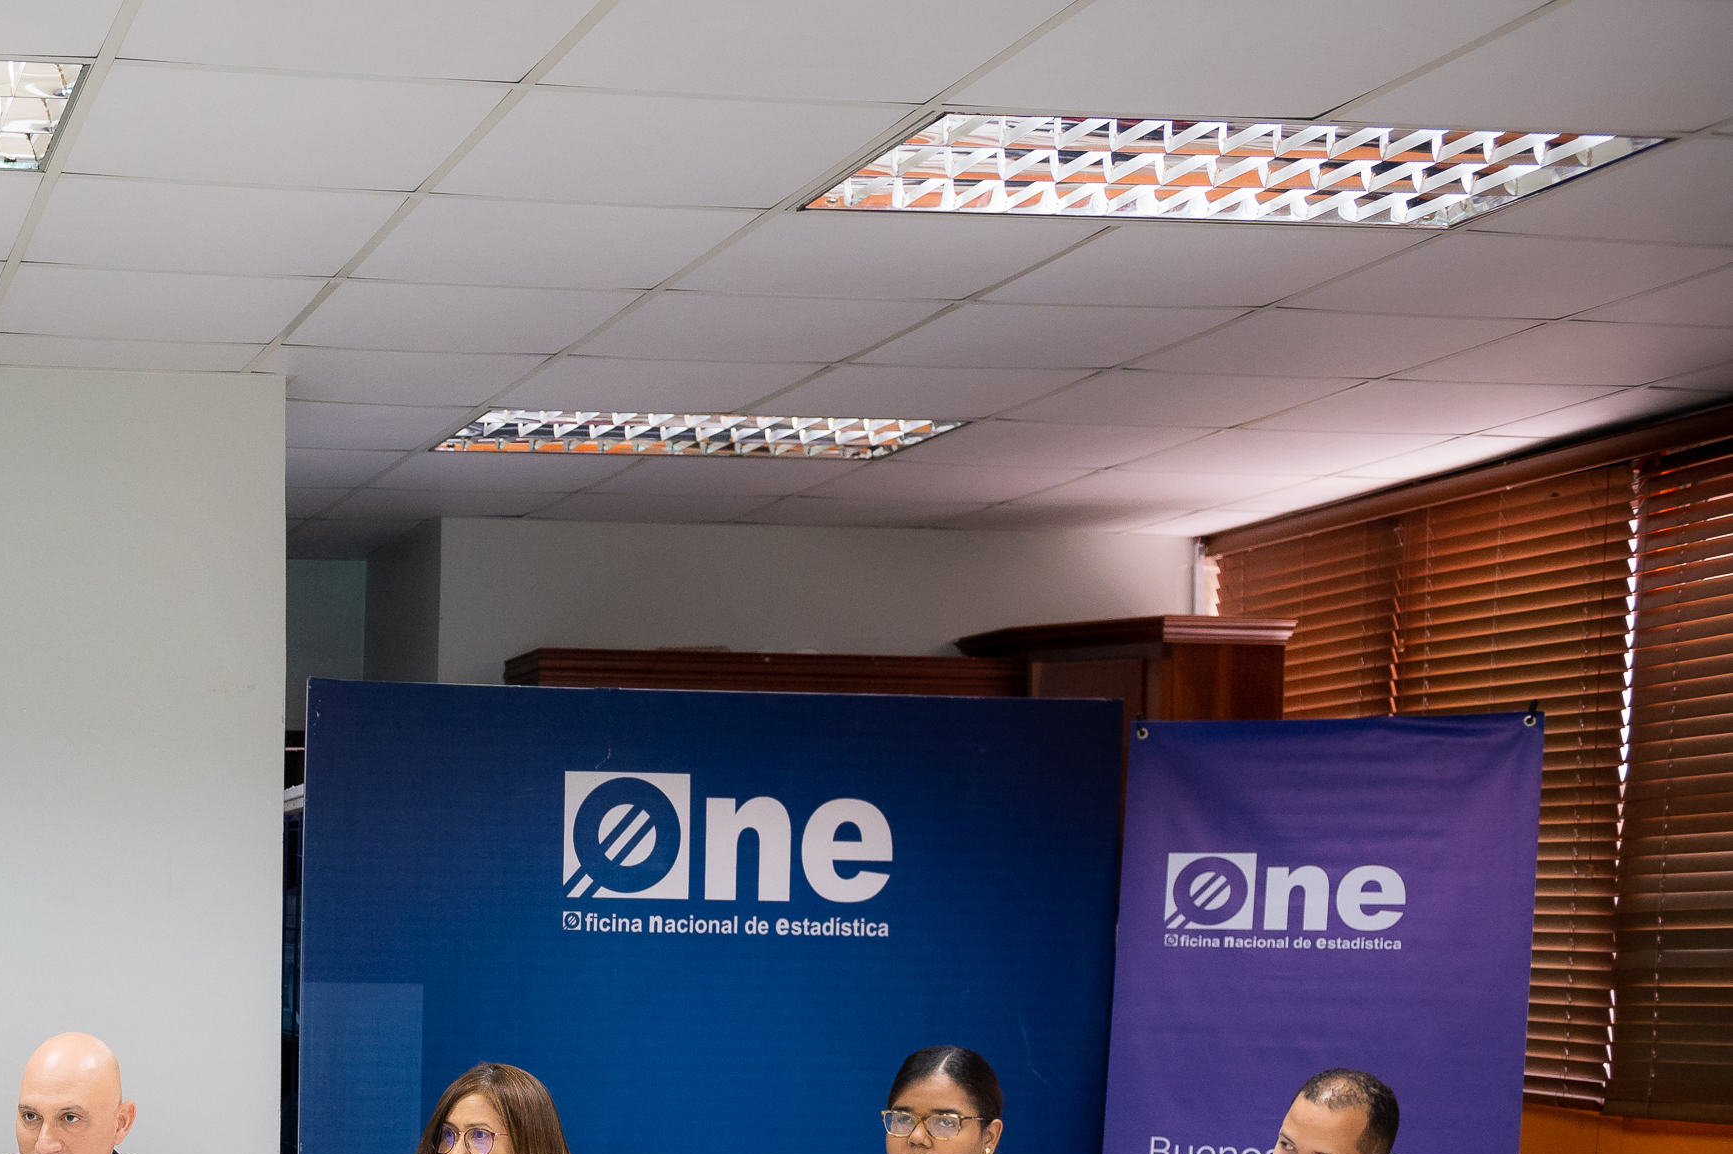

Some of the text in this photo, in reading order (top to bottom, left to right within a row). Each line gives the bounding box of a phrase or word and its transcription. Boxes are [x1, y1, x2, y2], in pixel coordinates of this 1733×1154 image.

[649, 914, 738, 935] nacional
[744, 916, 769, 935] de
[775, 917, 889, 937] estadística
[1224, 935, 1289, 949] nacional
[1293, 936, 1312, 949] de
